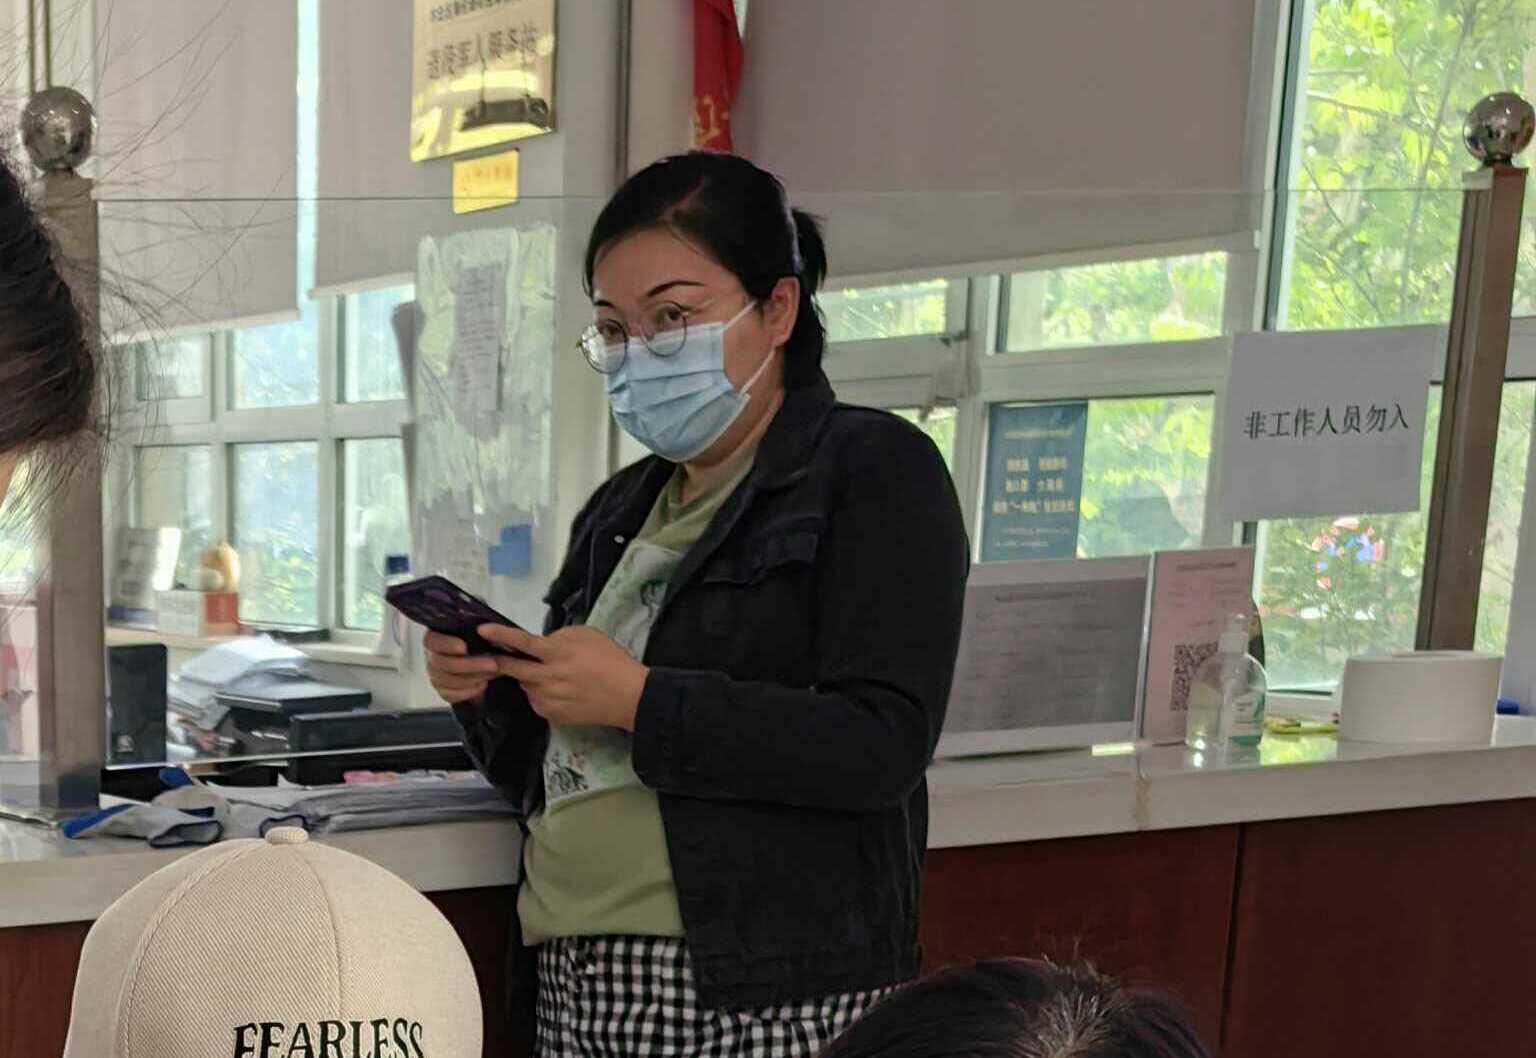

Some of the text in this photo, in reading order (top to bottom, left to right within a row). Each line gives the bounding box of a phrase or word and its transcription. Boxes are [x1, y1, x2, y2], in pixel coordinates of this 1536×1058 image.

[1244, 403, 1409, 439] 非工作人员勿入
